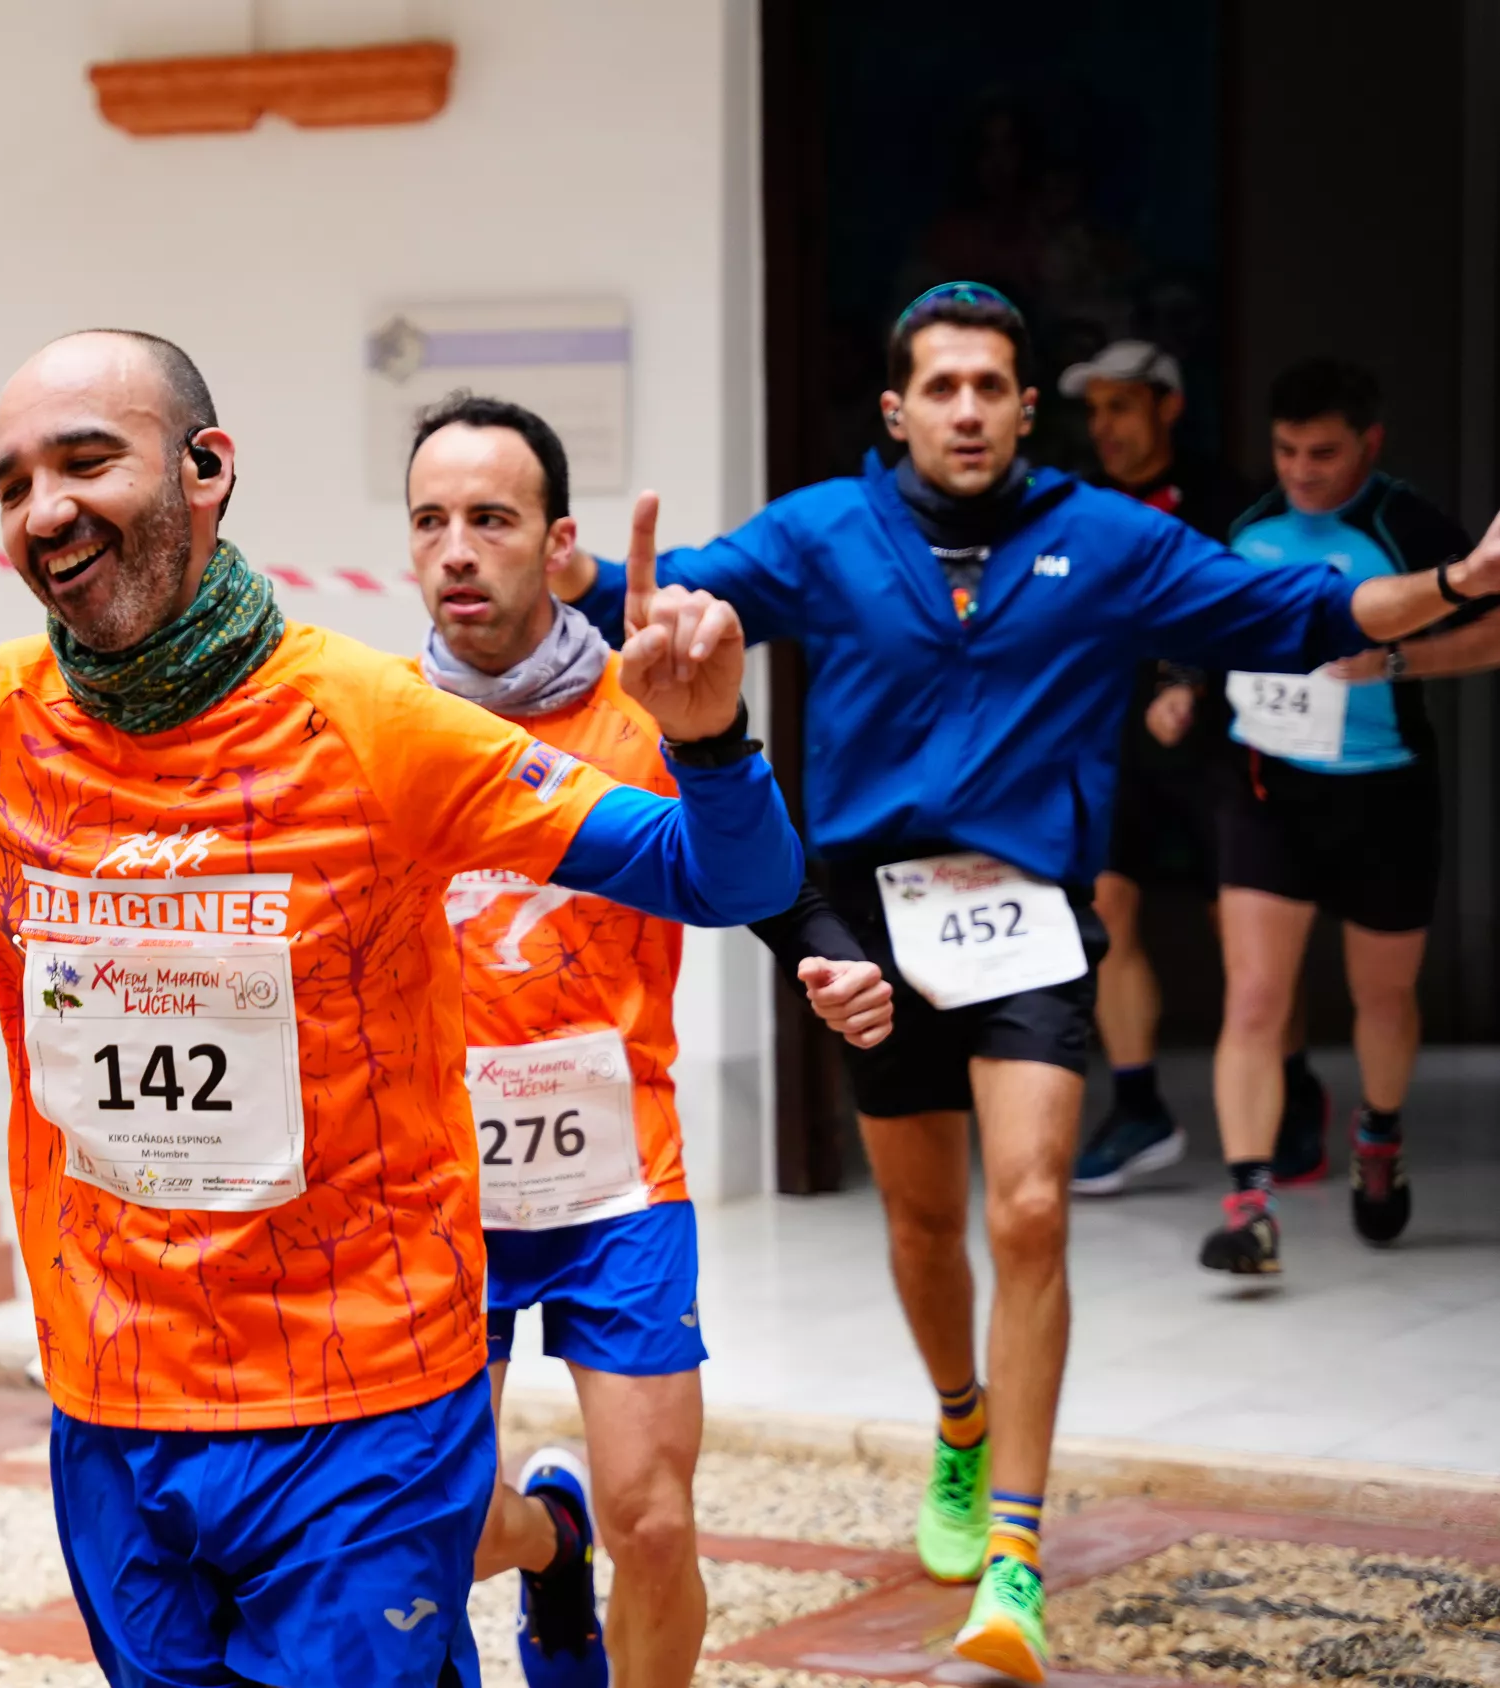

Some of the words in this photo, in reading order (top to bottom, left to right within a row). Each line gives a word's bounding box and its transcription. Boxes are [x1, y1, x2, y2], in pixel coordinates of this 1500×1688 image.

[940, 899, 1029, 947] 452
[124, 988, 210, 1017] LUCENA
[94, 1043, 233, 1112] 142
[108, 1133, 130, 1143] KIKO
[132, 1132, 175, 1145] CAÑADAS
[177, 1134, 222, 1145] ESPINOSA
[141, 1148, 190, 1159] M-Hombre
[479, 1108, 586, 1166] 276
